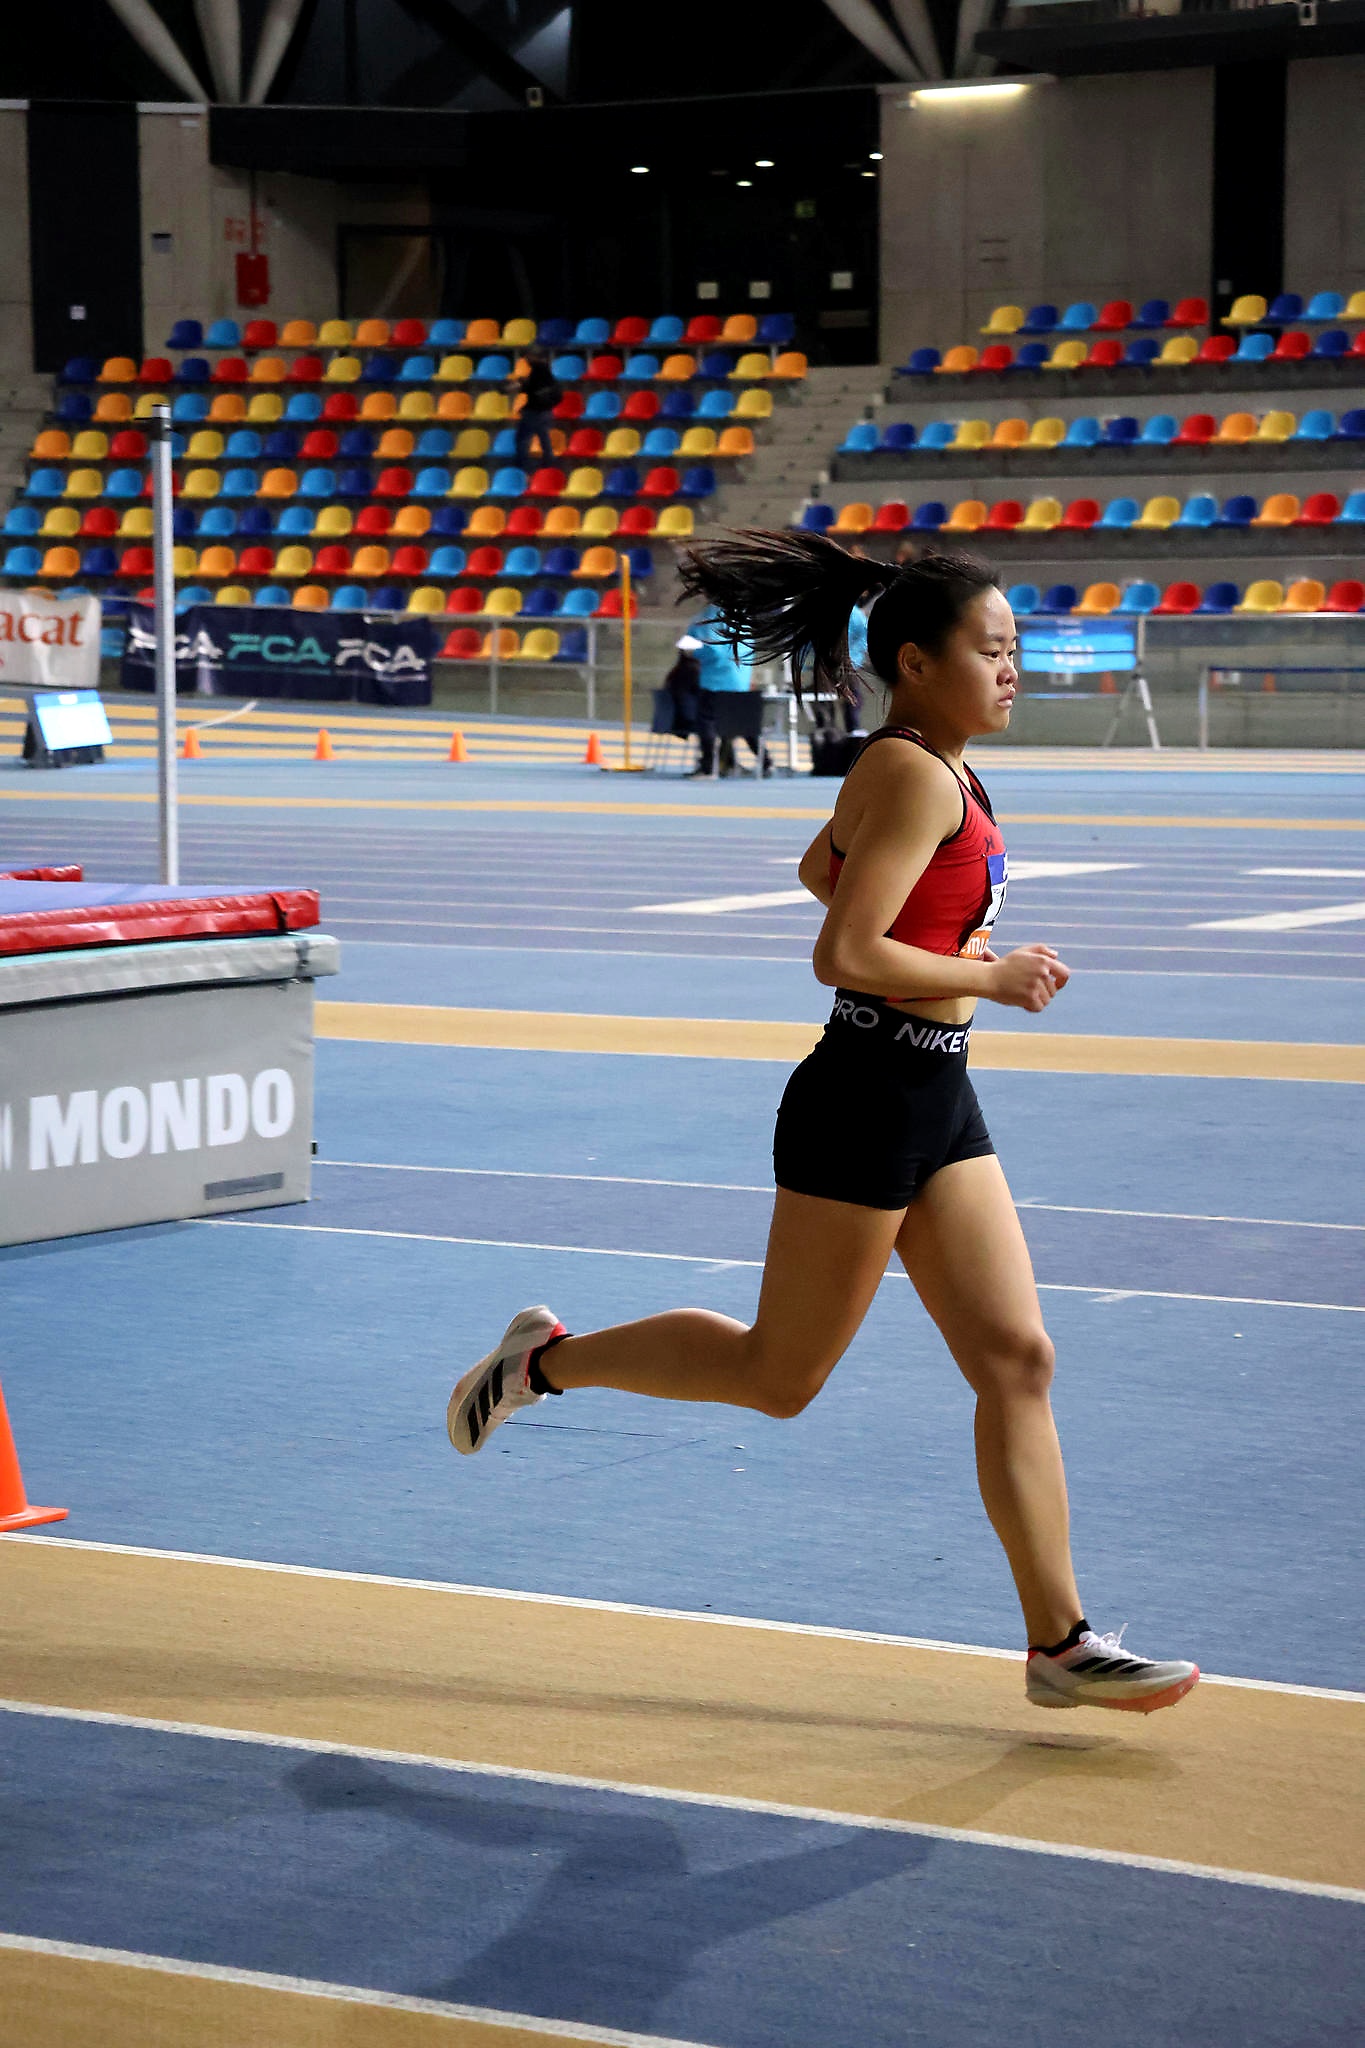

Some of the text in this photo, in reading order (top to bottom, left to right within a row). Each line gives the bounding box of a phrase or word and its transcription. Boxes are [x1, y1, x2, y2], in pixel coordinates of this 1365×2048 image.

[227, 633, 331, 665] FCA
[334, 638, 427, 673] FCA
[29, 1067, 296, 1171] MONDO
